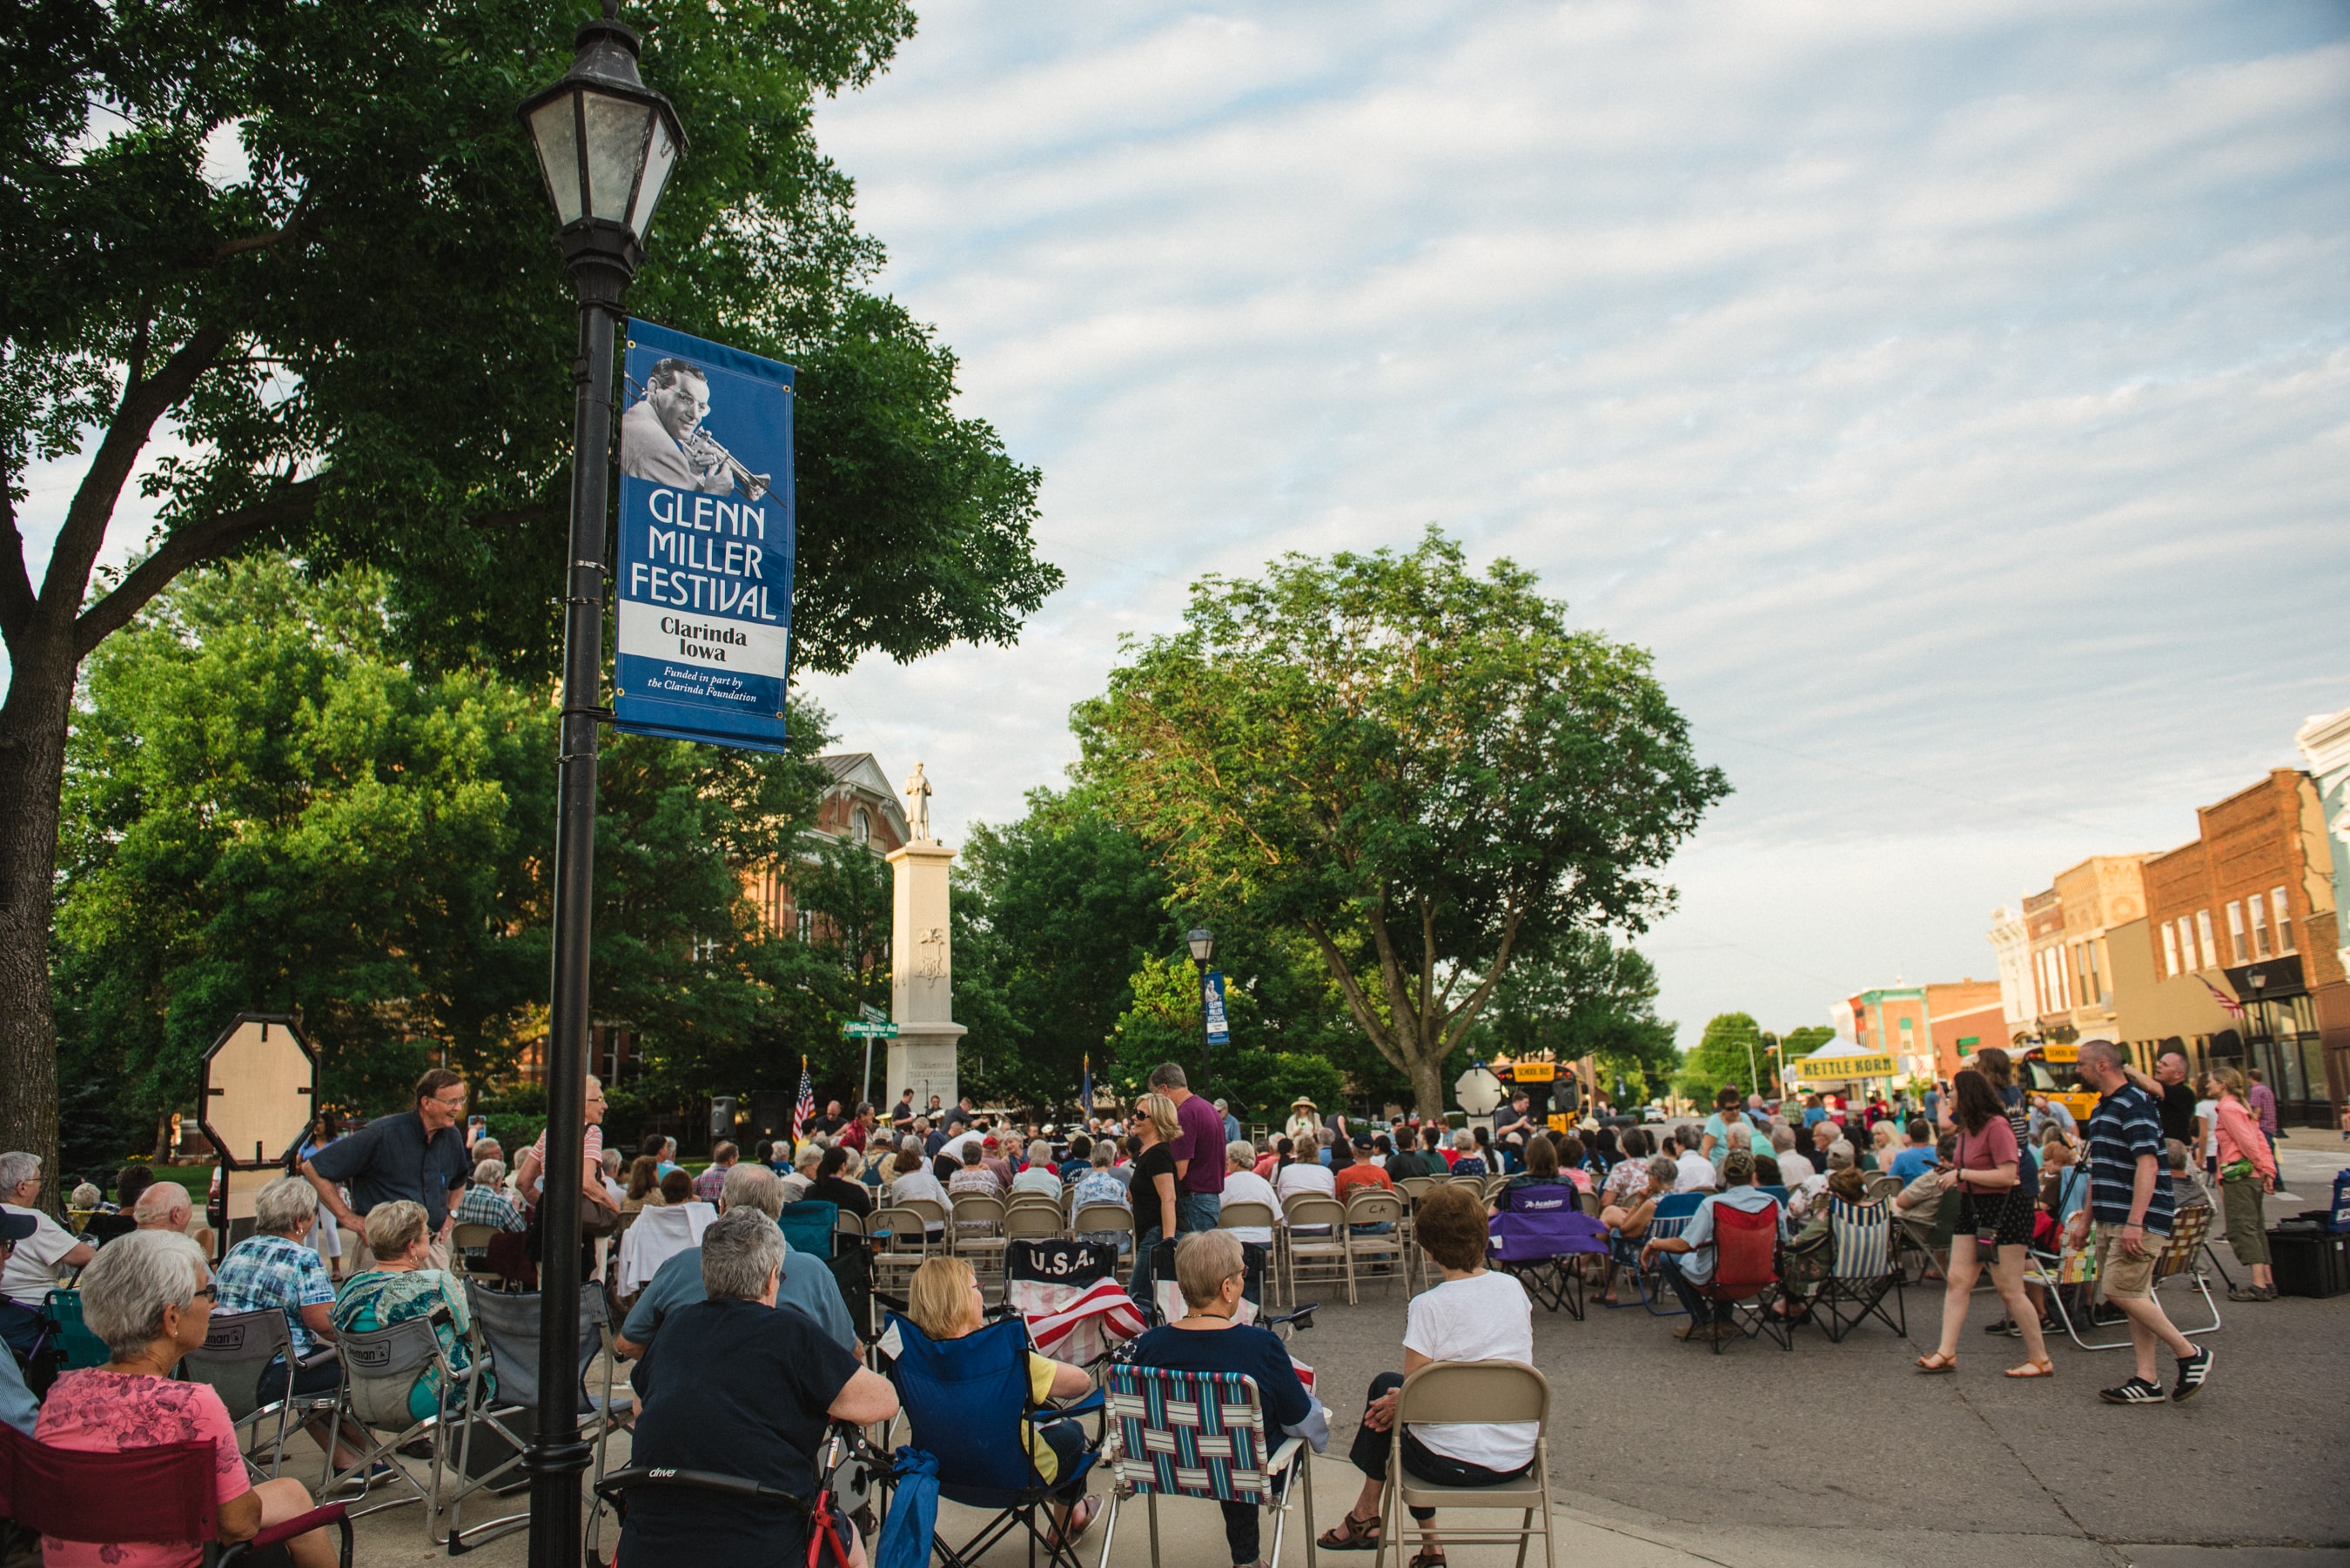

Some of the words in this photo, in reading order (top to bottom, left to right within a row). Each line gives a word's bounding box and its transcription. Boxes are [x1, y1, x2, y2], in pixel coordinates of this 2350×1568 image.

[648, 488, 765, 540] GLENN
[648, 525, 763, 580] MILLER
[631, 561, 777, 621] FESTIVAL
[660, 616, 748, 647] Clarinda
[679, 638, 727, 662] Iowa
[647, 677, 662, 688] the
[664, 680, 704, 695] Clarinda
[706, 687, 757, 703] Foundation
[663, 666, 697, 681] Funded
[699, 672, 708, 683] in
[709, 674, 731, 687] part
[731, 678, 743, 689] by
[1803, 1060, 1850, 1076] KETTLE
[1534, 1199, 1563, 1208] Academy
[876, 1215, 895, 1229] CA
[1030, 1249, 1095, 1276] U.S.A.
[648, 1467, 675, 1478] drive
